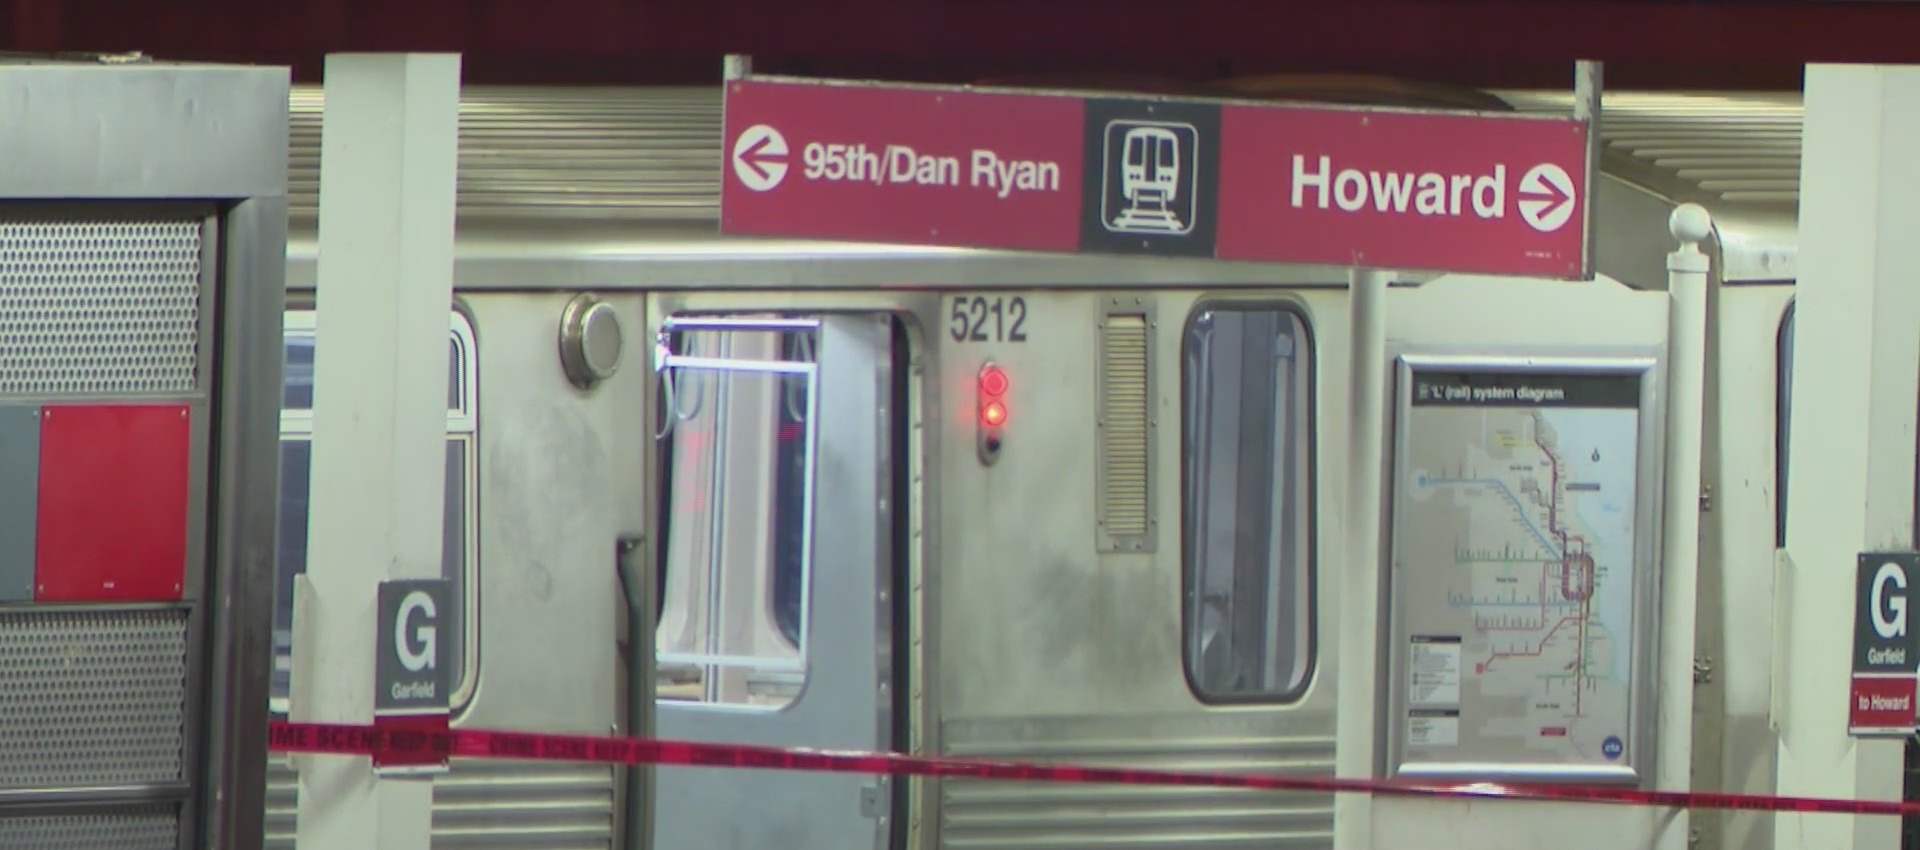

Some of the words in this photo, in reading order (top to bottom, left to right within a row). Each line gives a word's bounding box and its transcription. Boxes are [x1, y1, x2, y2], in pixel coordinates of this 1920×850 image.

[803, 142, 960, 186] 95th/Dan
[970, 149, 1060, 198] Ryan
[1291, 153, 1507, 219] Howard
[950, 296, 1027, 342] 5212
[1445, 384, 1471, 401] (rail)
[1473, 386, 1515, 401] system
[1516, 386, 1565, 402] diagram
[1871, 562, 1908, 639] G
[395, 590, 437, 672] G
[1867, 647, 1906, 665] Garfield
[391, 682, 436, 699] Garfield
[1858, 694, 1870, 711] to
[1871, 694, 1911, 711] Howard
[267, 726, 305, 746] IME
